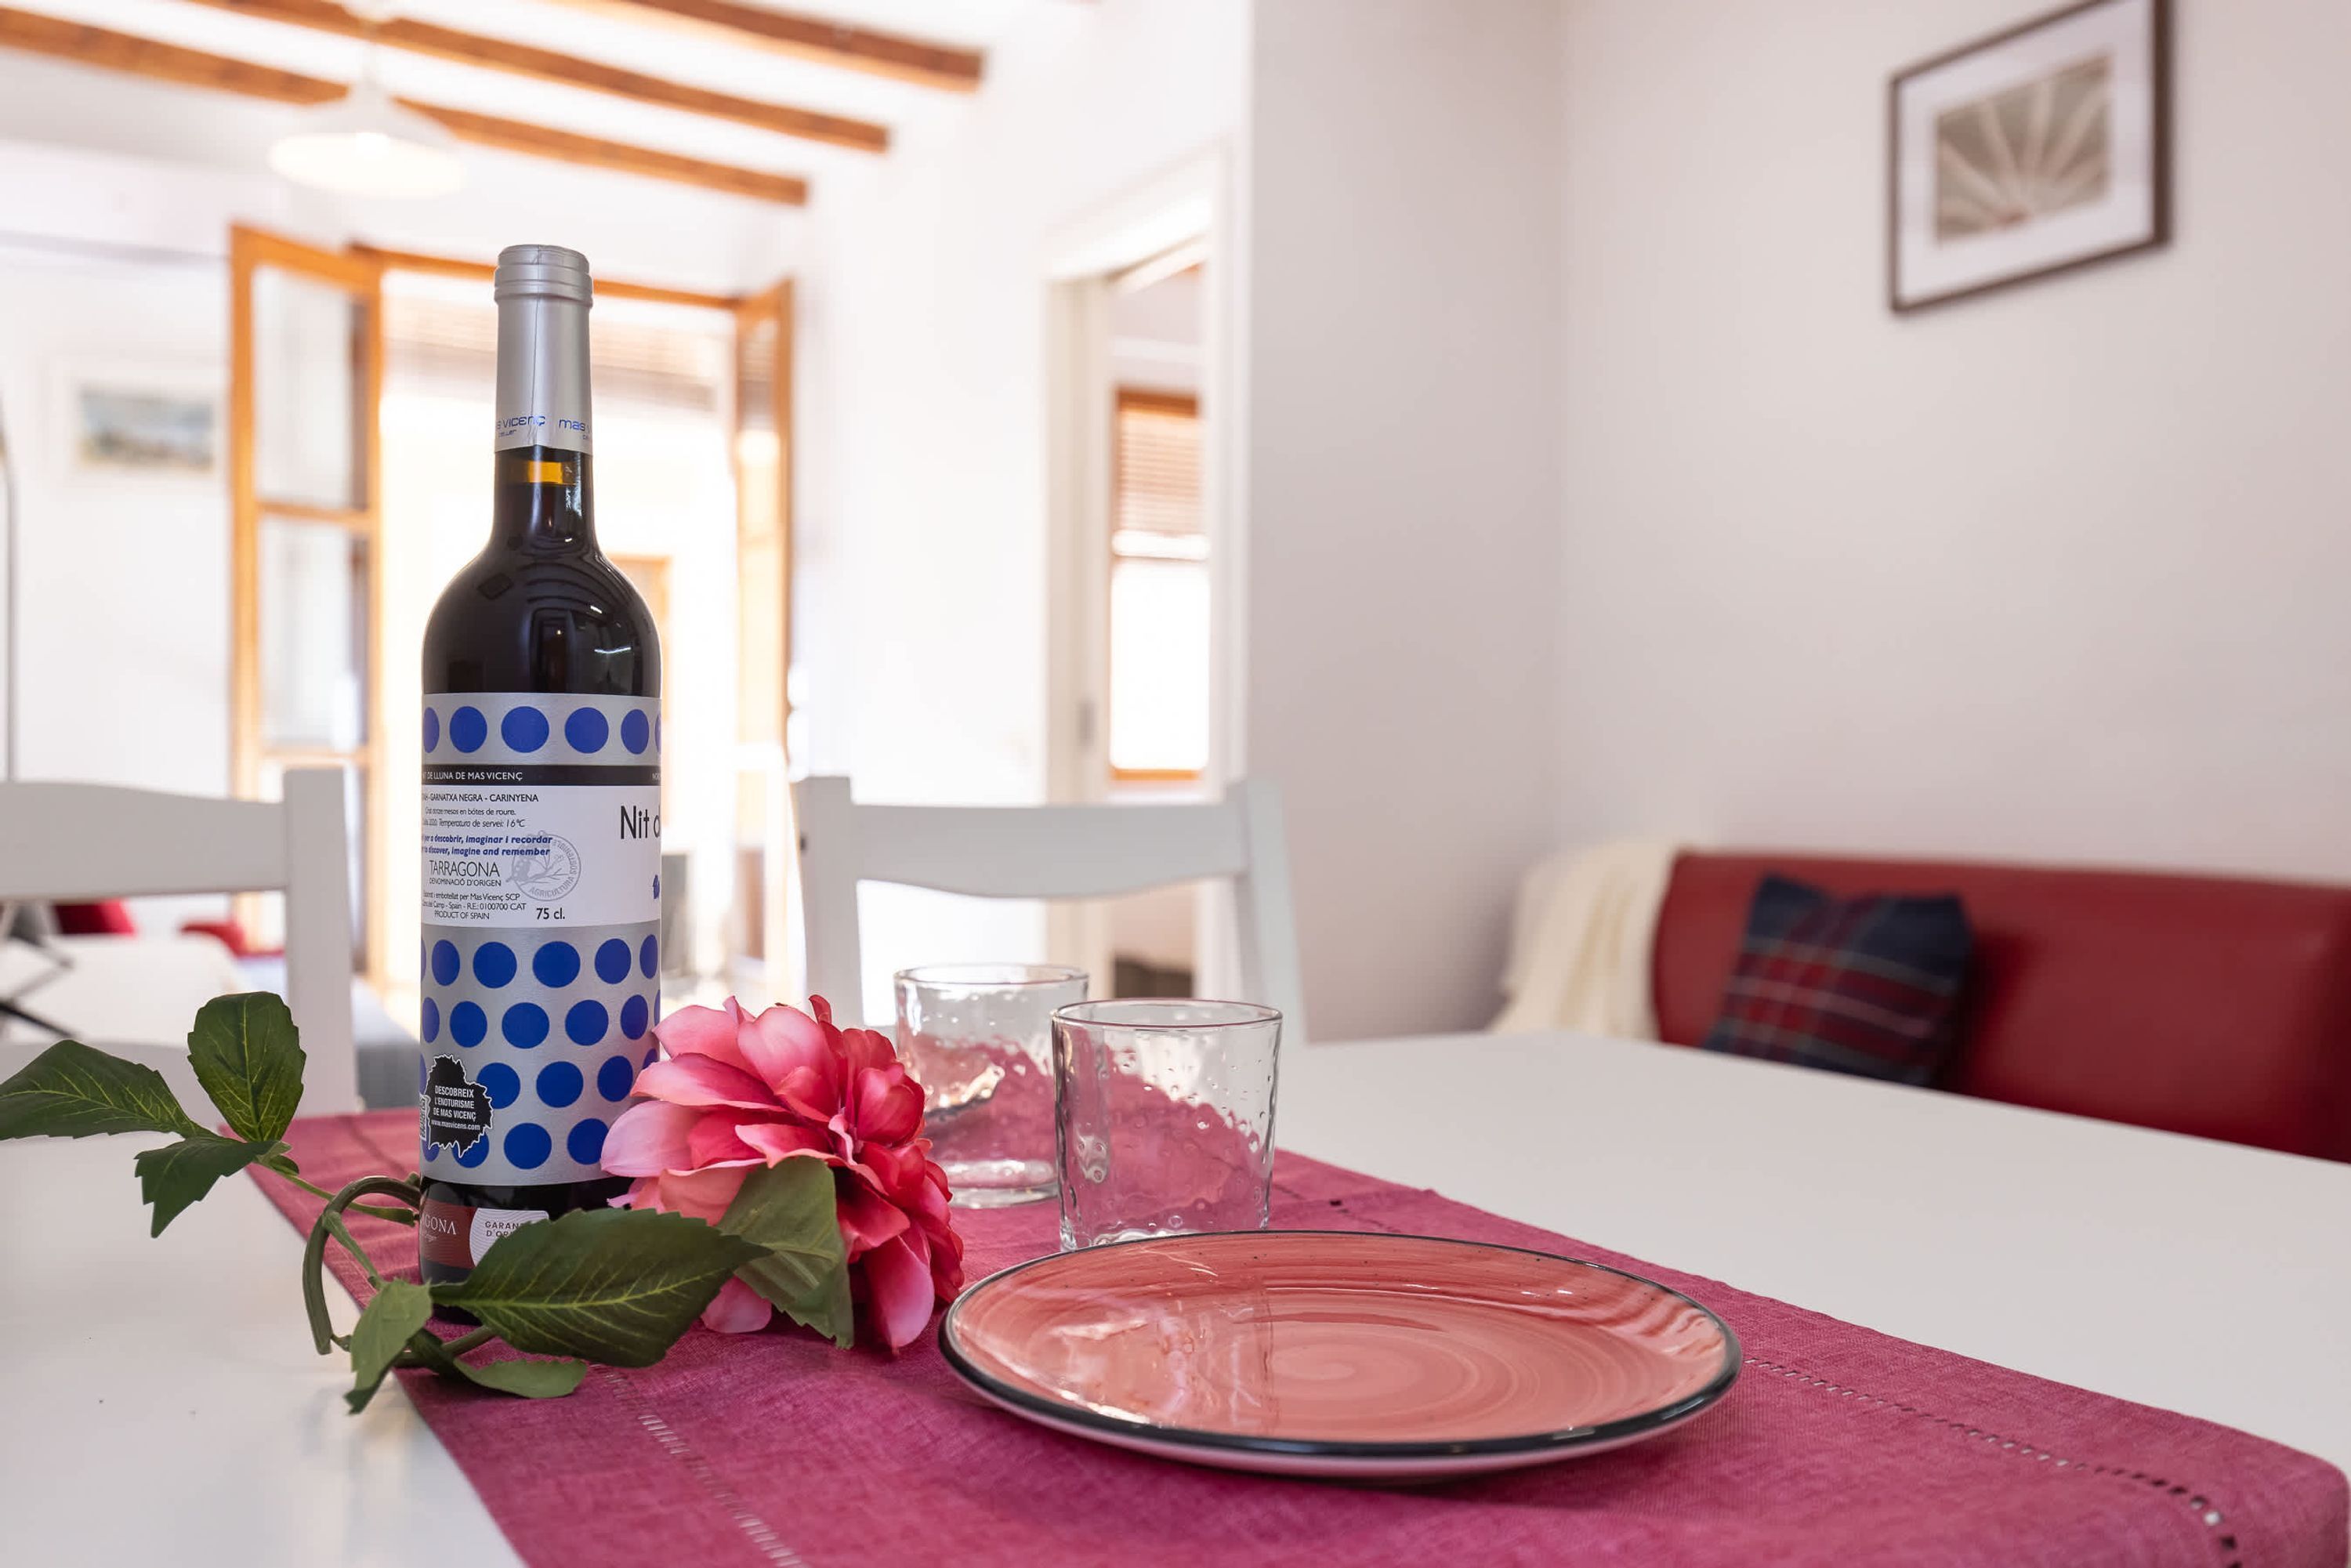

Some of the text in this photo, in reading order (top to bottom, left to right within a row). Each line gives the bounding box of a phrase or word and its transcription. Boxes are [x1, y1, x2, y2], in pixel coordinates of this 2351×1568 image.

[467, 772, 485, 780] MAS
[486, 772, 523, 781] VICENÇ
[489, 794, 539, 802] CARINYENA
[472, 819, 481, 827] de
[621, 806, 650, 839] Nit
[465, 835, 503, 846] imaginar
[511, 835, 553, 844] recordar
[451, 847, 481, 857] imagine
[429, 860, 501, 878] TARRAGONA
[466, 878, 502, 887] D'ORIGEN
[530, 876, 575, 897] AGRICULTURA
[434, 910, 459, 918] PRODUCT
[536, 907, 566, 920] 75 cl.
[434, 1085, 474, 1098] DESCOBREIX
[434, 1096, 475, 1109] L'ENOTURISME
[433, 1107, 476, 1122] DE MAS VICENÇ
[485, 1221, 520, 1229] GARAN
